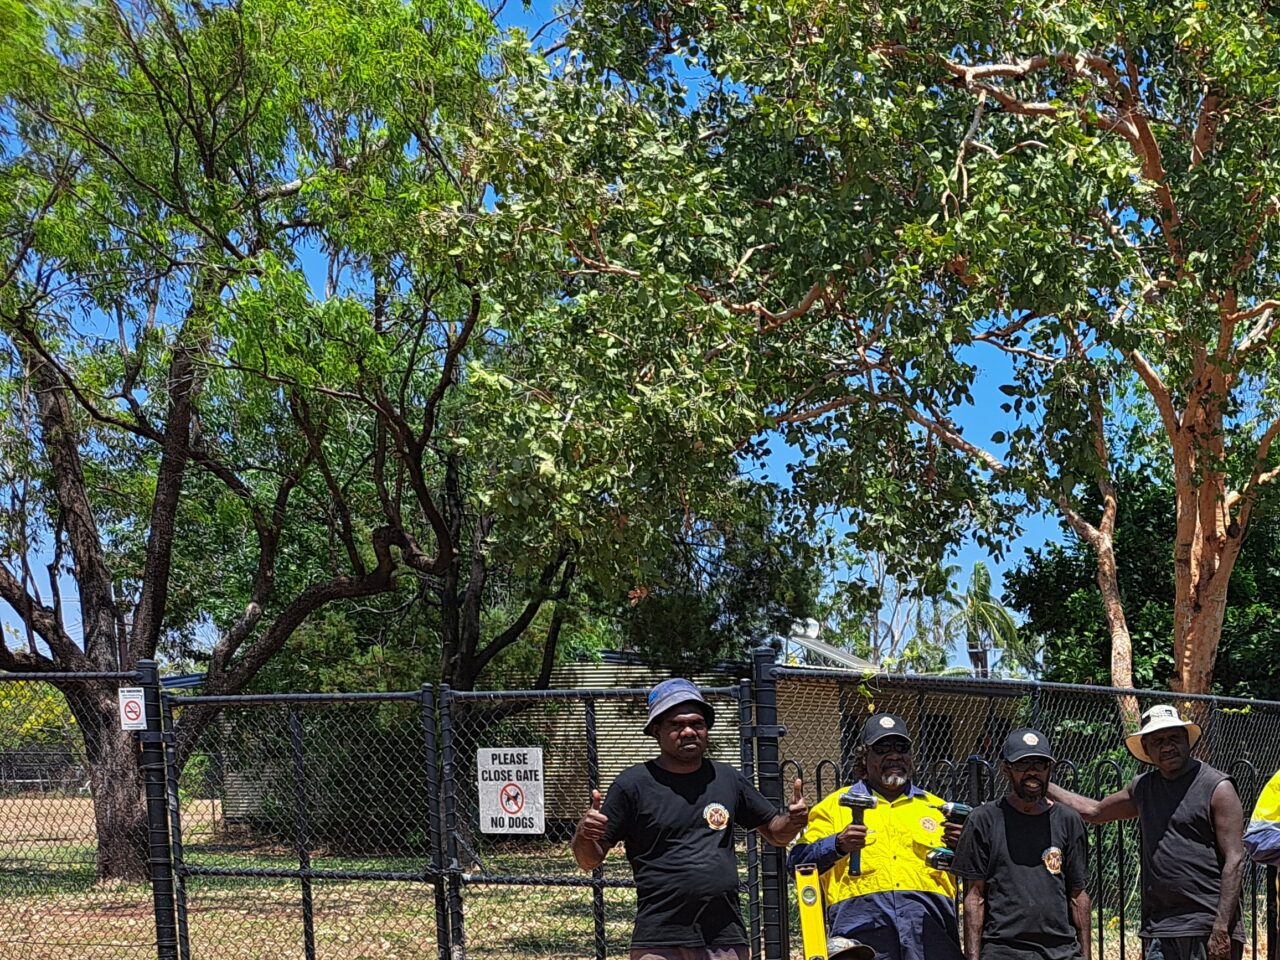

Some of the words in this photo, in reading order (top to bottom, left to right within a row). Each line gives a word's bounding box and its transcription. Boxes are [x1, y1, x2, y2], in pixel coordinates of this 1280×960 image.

[491, 753, 528, 765] PLEASE
[481, 769, 513, 782] CLOSE
[515, 769, 540, 782] GATE
[490, 816, 505, 829] NO
[508, 816, 535, 829] DOGS
